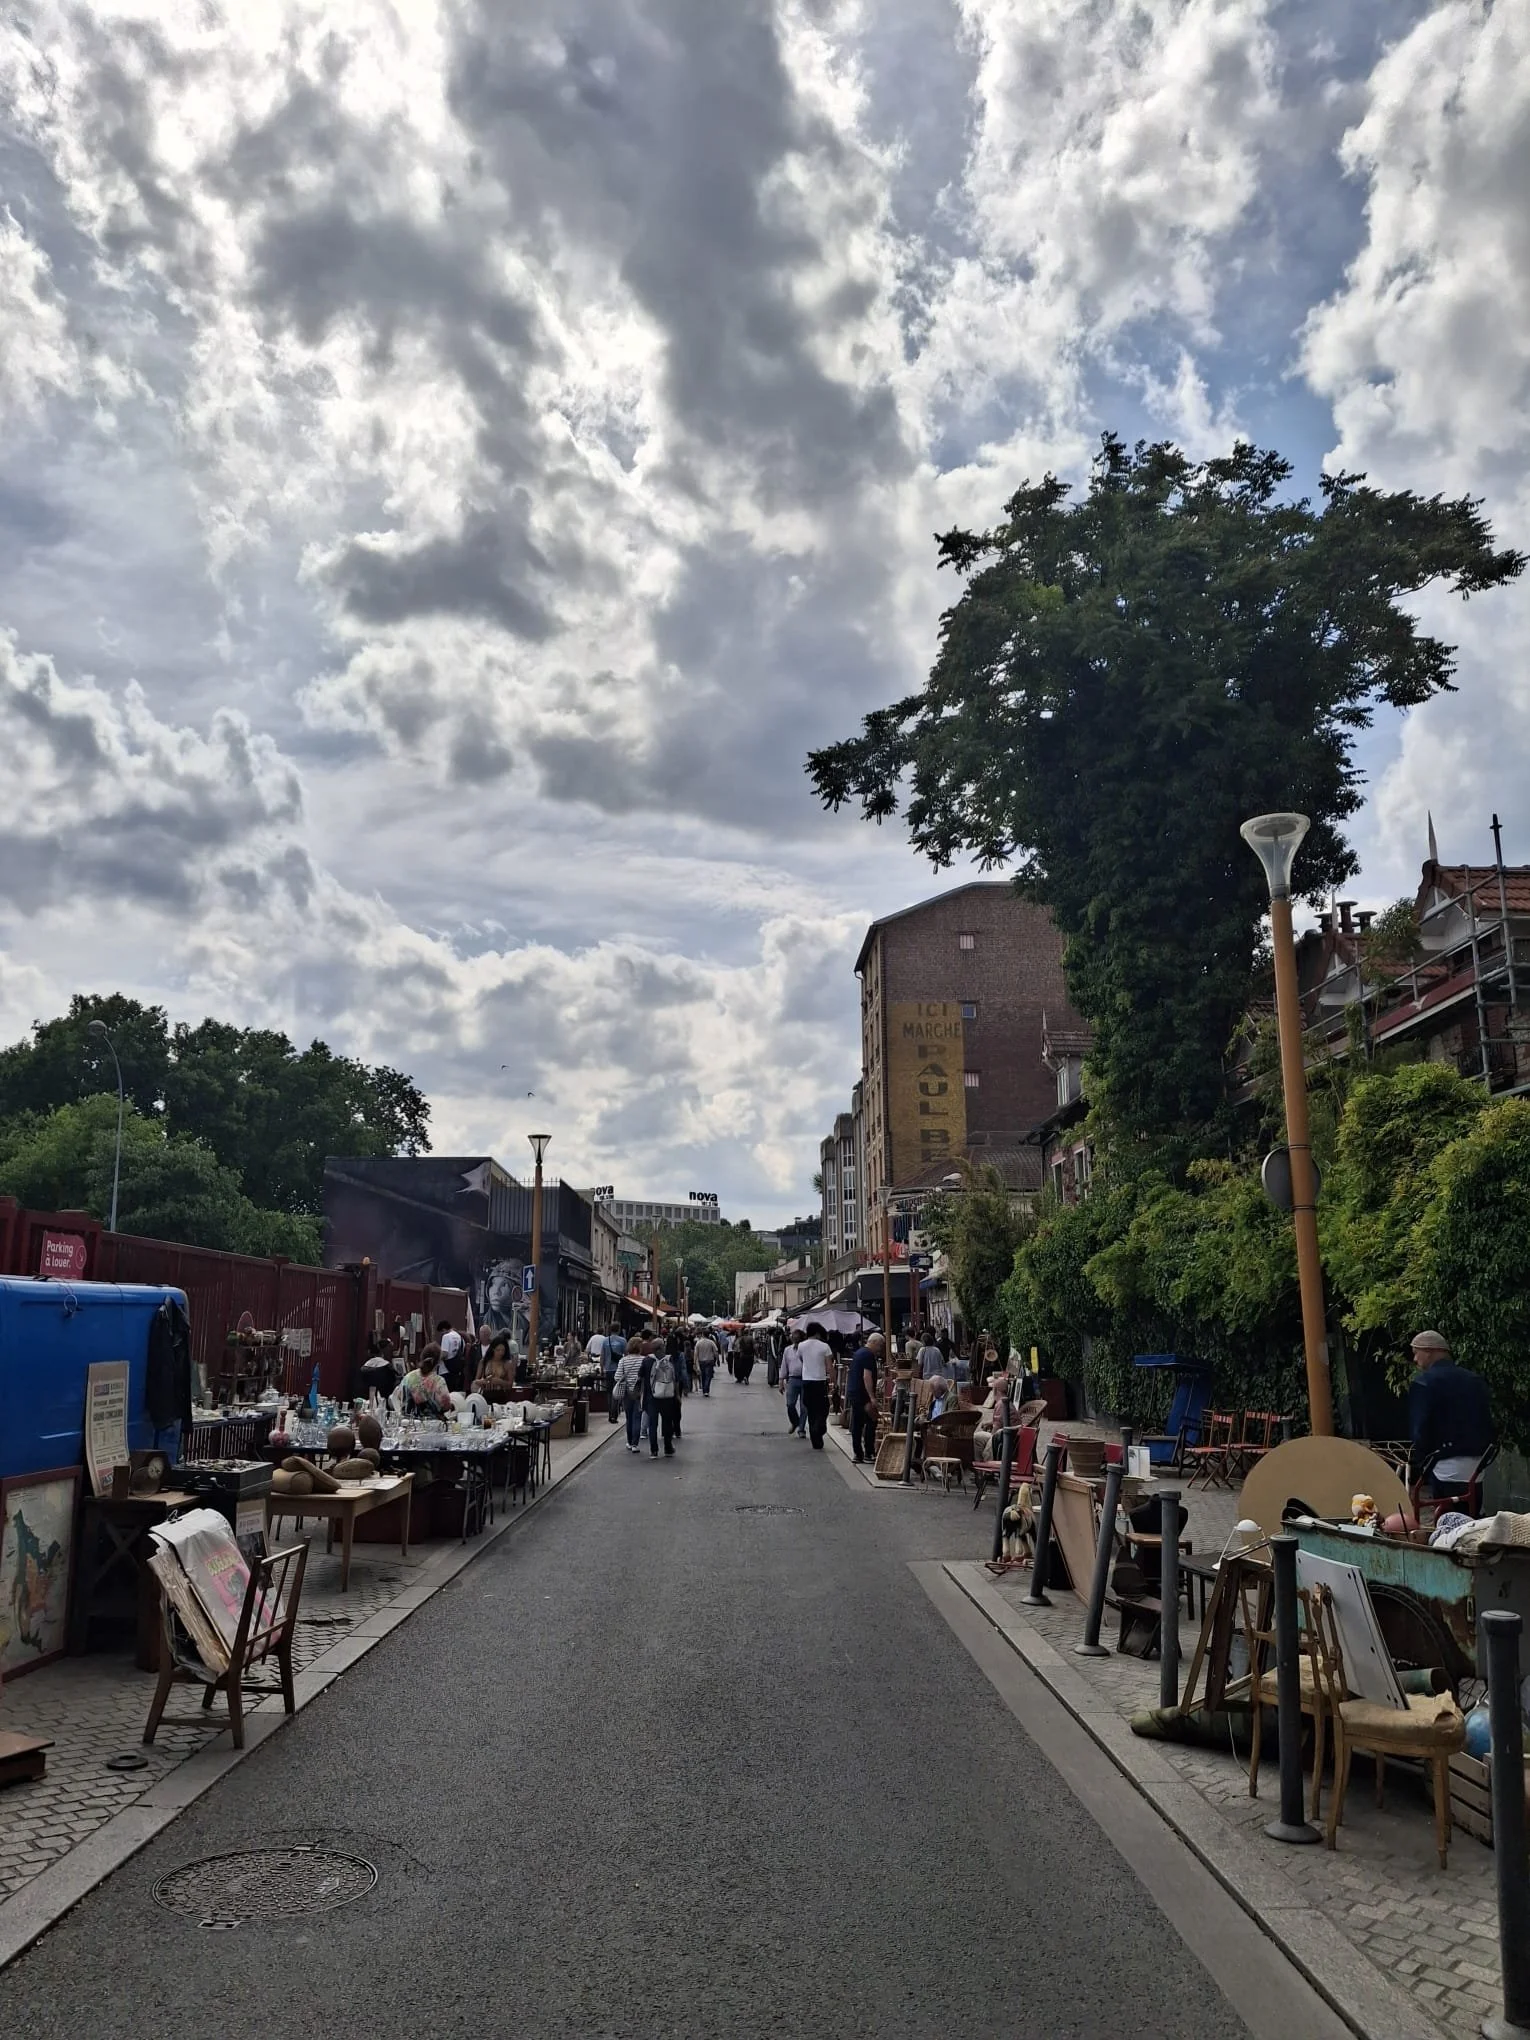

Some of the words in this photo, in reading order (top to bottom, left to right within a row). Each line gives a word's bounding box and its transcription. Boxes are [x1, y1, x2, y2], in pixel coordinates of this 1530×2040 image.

[918, 1003, 947, 1017] ICI
[689, 1191, 718, 1201] nova
[47, 1240, 73, 1257] Parking
